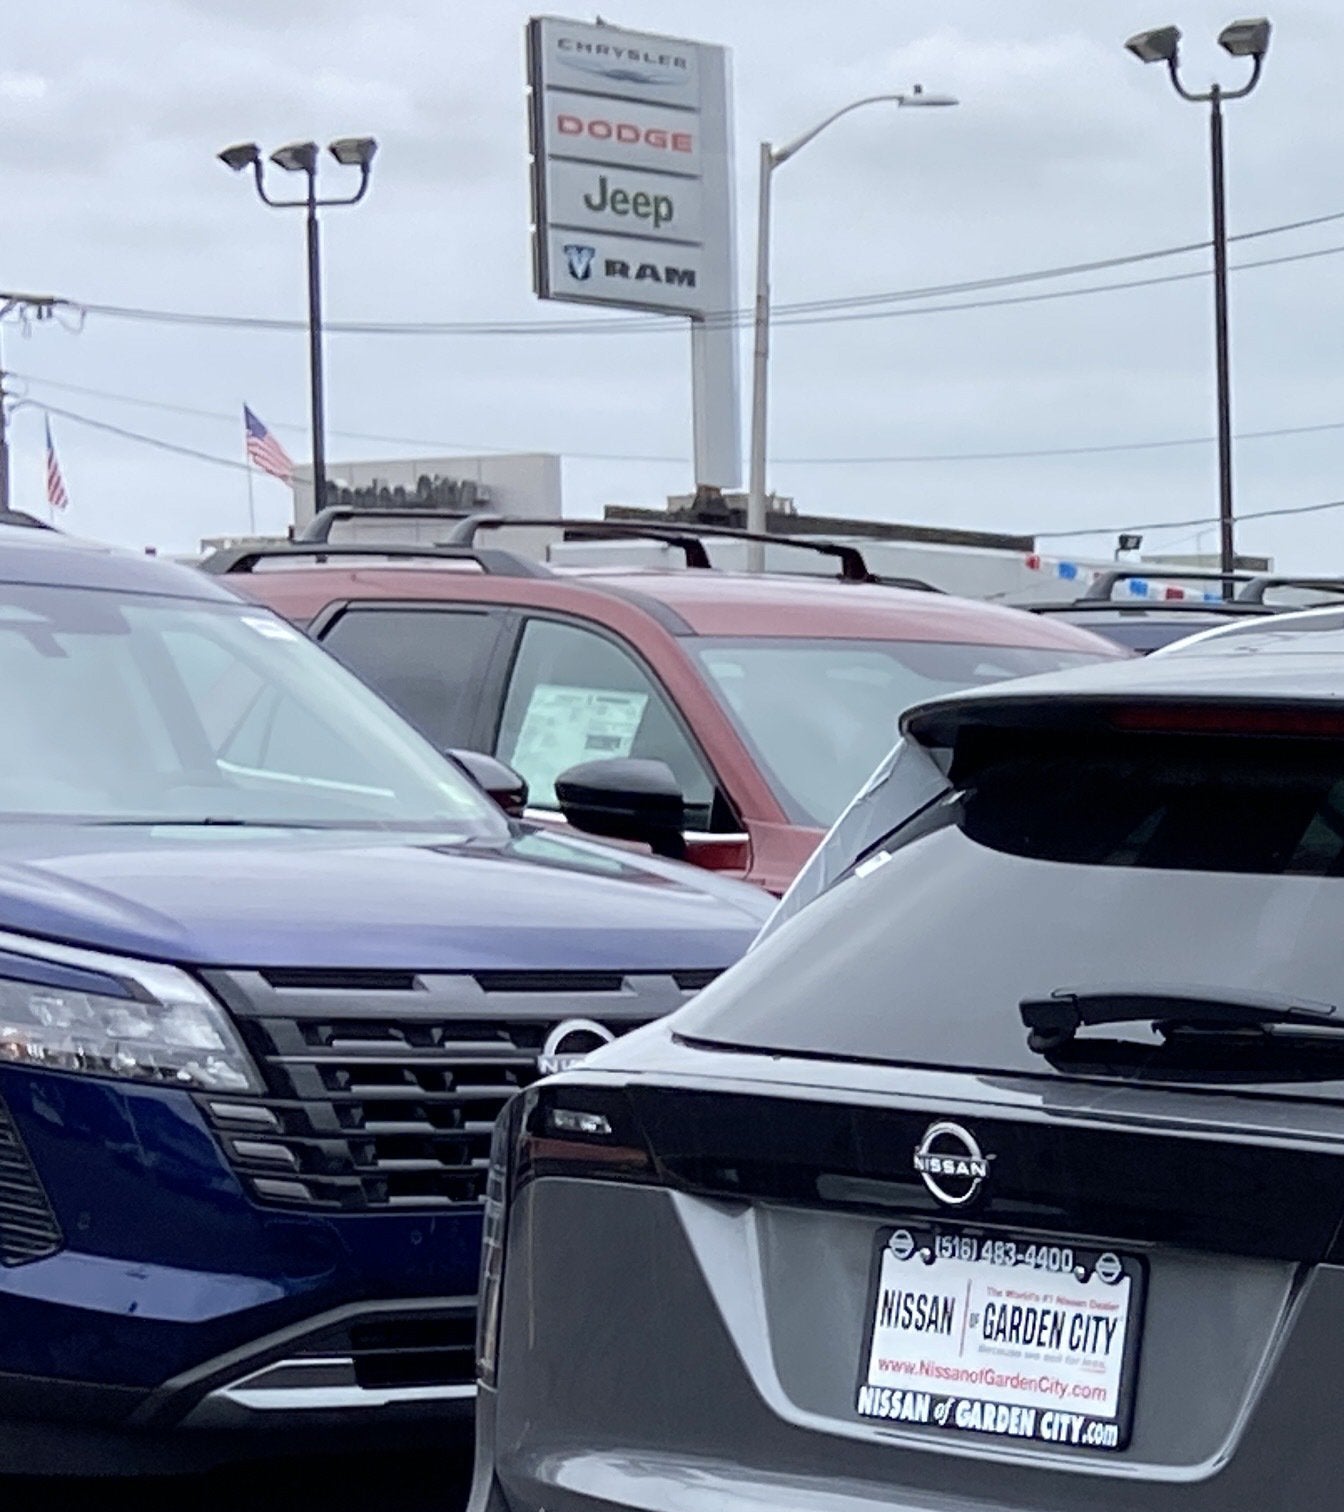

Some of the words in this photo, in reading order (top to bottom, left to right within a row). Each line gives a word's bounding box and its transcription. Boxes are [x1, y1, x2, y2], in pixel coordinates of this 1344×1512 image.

[557, 37, 687, 70] CHRYSLER
[557, 114, 693, 154] DODGE
[583, 175, 674, 229] Jeep
[604, 258, 697, 289] RAM
[913, 1153, 987, 1177] NISSAN
[934, 1235, 978, 1261] (516)
[980, 1240, 1074, 1273] 483-4400
[880, 1289, 956, 1336] NISSAN
[982, 1302, 1066, 1350] GARDEN
[1069, 1313, 1118, 1356] CITY
[878, 1357, 1107, 1401] www.NissanofGardenCity.com
[857, 1385, 932, 1424] NISSAN
[934, 1396, 955, 1426] of
[955, 1399, 1037, 1438] GARDEN
[1040, 1411, 1120, 1448] CITY.com
